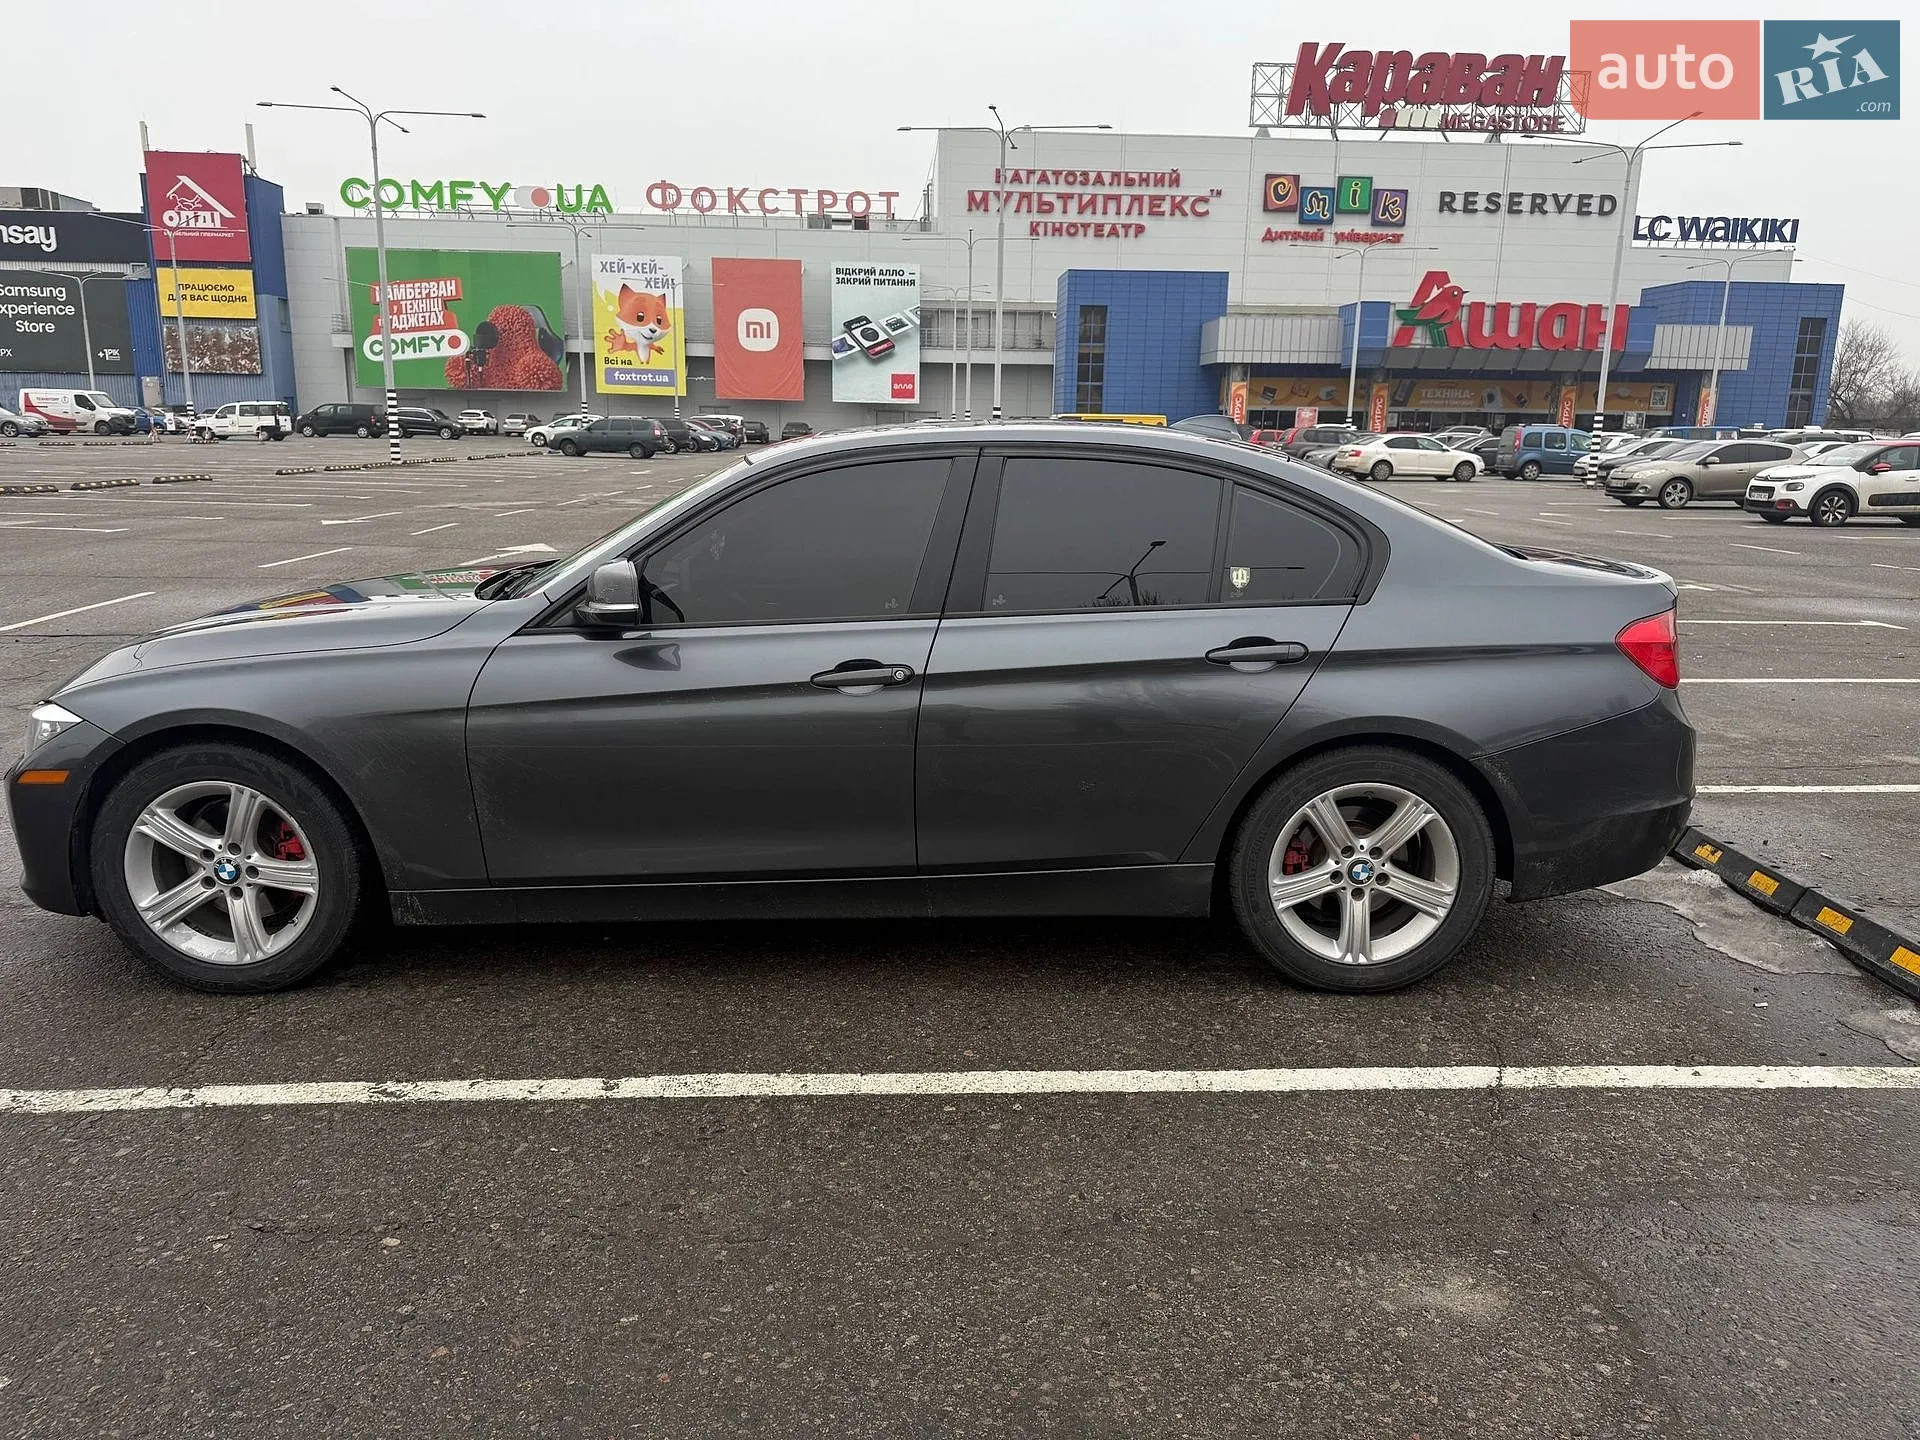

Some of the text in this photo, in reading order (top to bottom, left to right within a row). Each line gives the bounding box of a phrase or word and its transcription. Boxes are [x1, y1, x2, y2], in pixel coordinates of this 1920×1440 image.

[1284, 42, 1566, 118] Караван
[1439, 112, 1565, 132] MEGASTORE
[994, 168, 1181, 188] БАГАТОЗАЛЬНИЙ
[340, 177, 614, 214] COMFY UA
[646, 179, 899, 220] ФОКСТРОТ
[967, 190, 1210, 218] МУЛЬТИПЛЕКС
[1438, 191, 1618, 217] RESERVED
[1029, 221, 1146, 239] КІНОТЕАТР
[1261, 228, 1404, 245] Дитячий універмаг
[1632, 215, 1673, 241] LC
[835, 267, 876, 276] ВІДКРИЙ
[879, 269, 905, 277] АЛЛО
[178, 284, 235, 292] ПРАЦЮЄМО
[835, 277, 916, 287] ЗАКРИЙ ПИТАННЯ
[0, 284, 66, 301] Samsung
[168, 294, 248, 303] ДЯ ВАС ЩОДНЯ
[400, 298, 442, 315] ТЕХНІЦІ
[1392, 271, 1630, 351] Ашан
[15, 320, 56, 333] Store
[604, 356, 619, 365] Всі
[614, 371, 669, 382] foxtrot.ua
